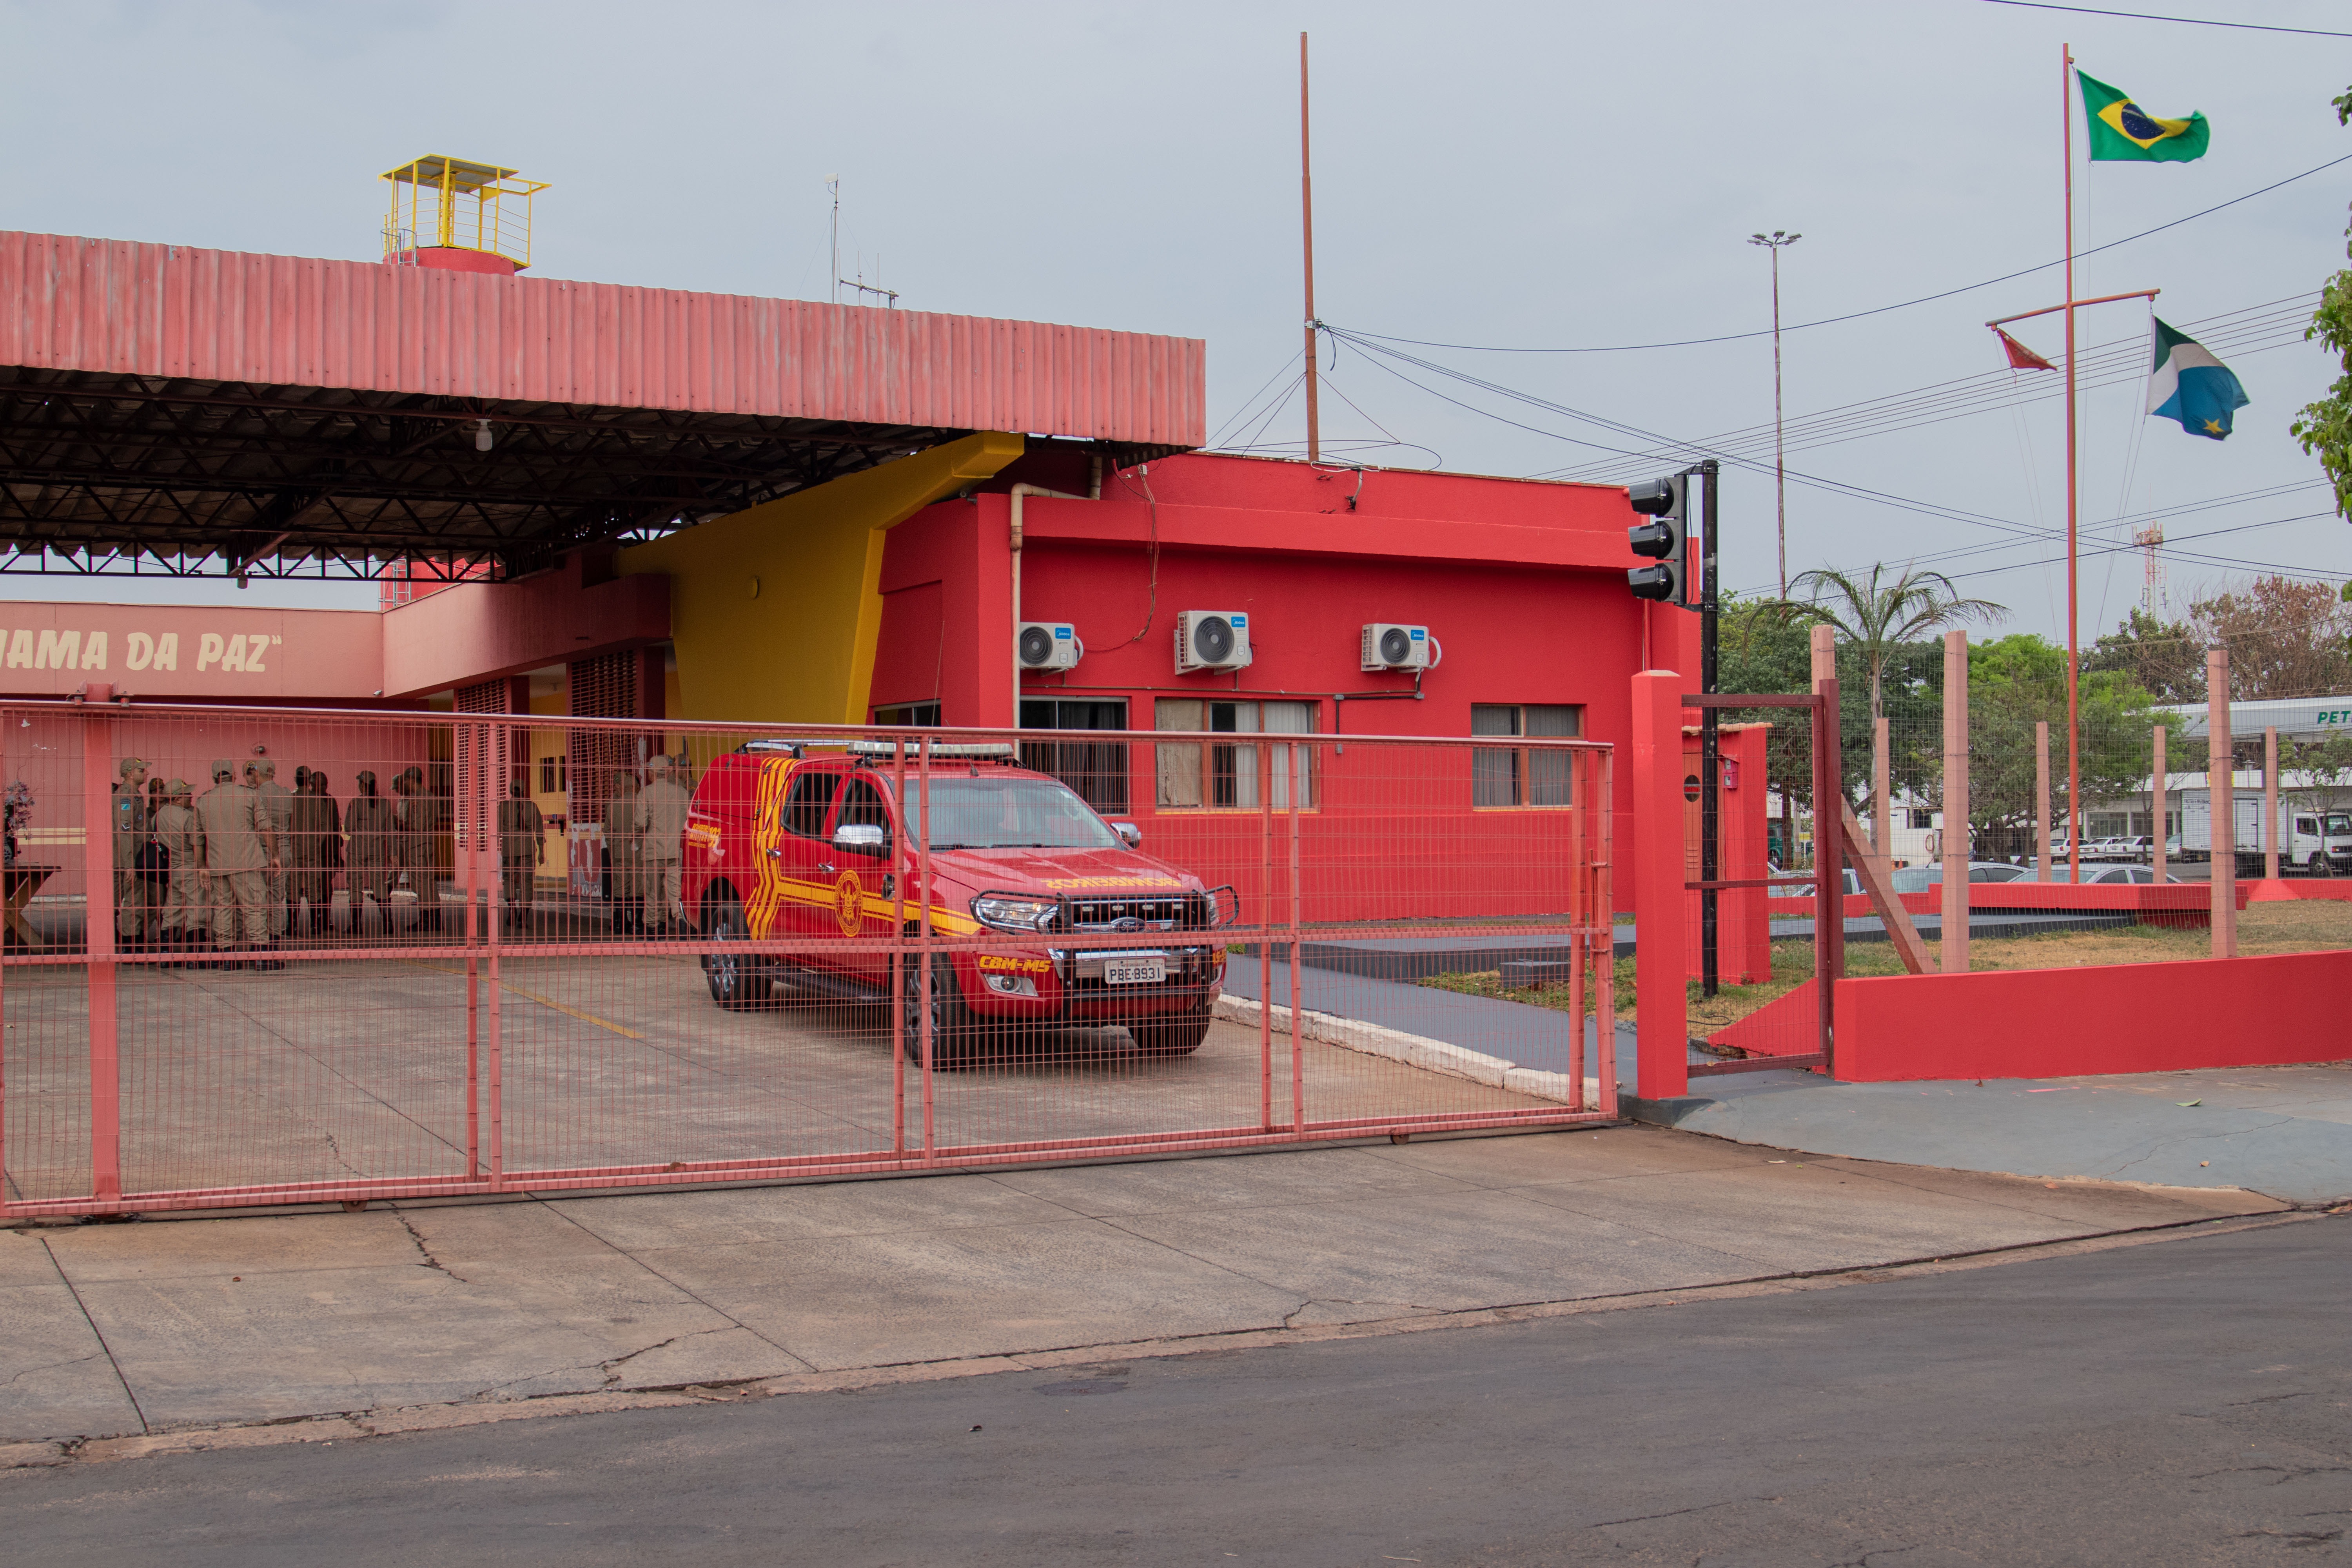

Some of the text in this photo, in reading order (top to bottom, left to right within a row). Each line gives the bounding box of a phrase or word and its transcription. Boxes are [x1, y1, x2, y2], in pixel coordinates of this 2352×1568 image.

[0, 629, 107, 670] AMA
[126, 632, 178, 671] DA
[2317, 710, 2352, 724] PET
[1121, 922, 1140, 931] Ford
[979, 956, 1051, 973] CBM-MS
